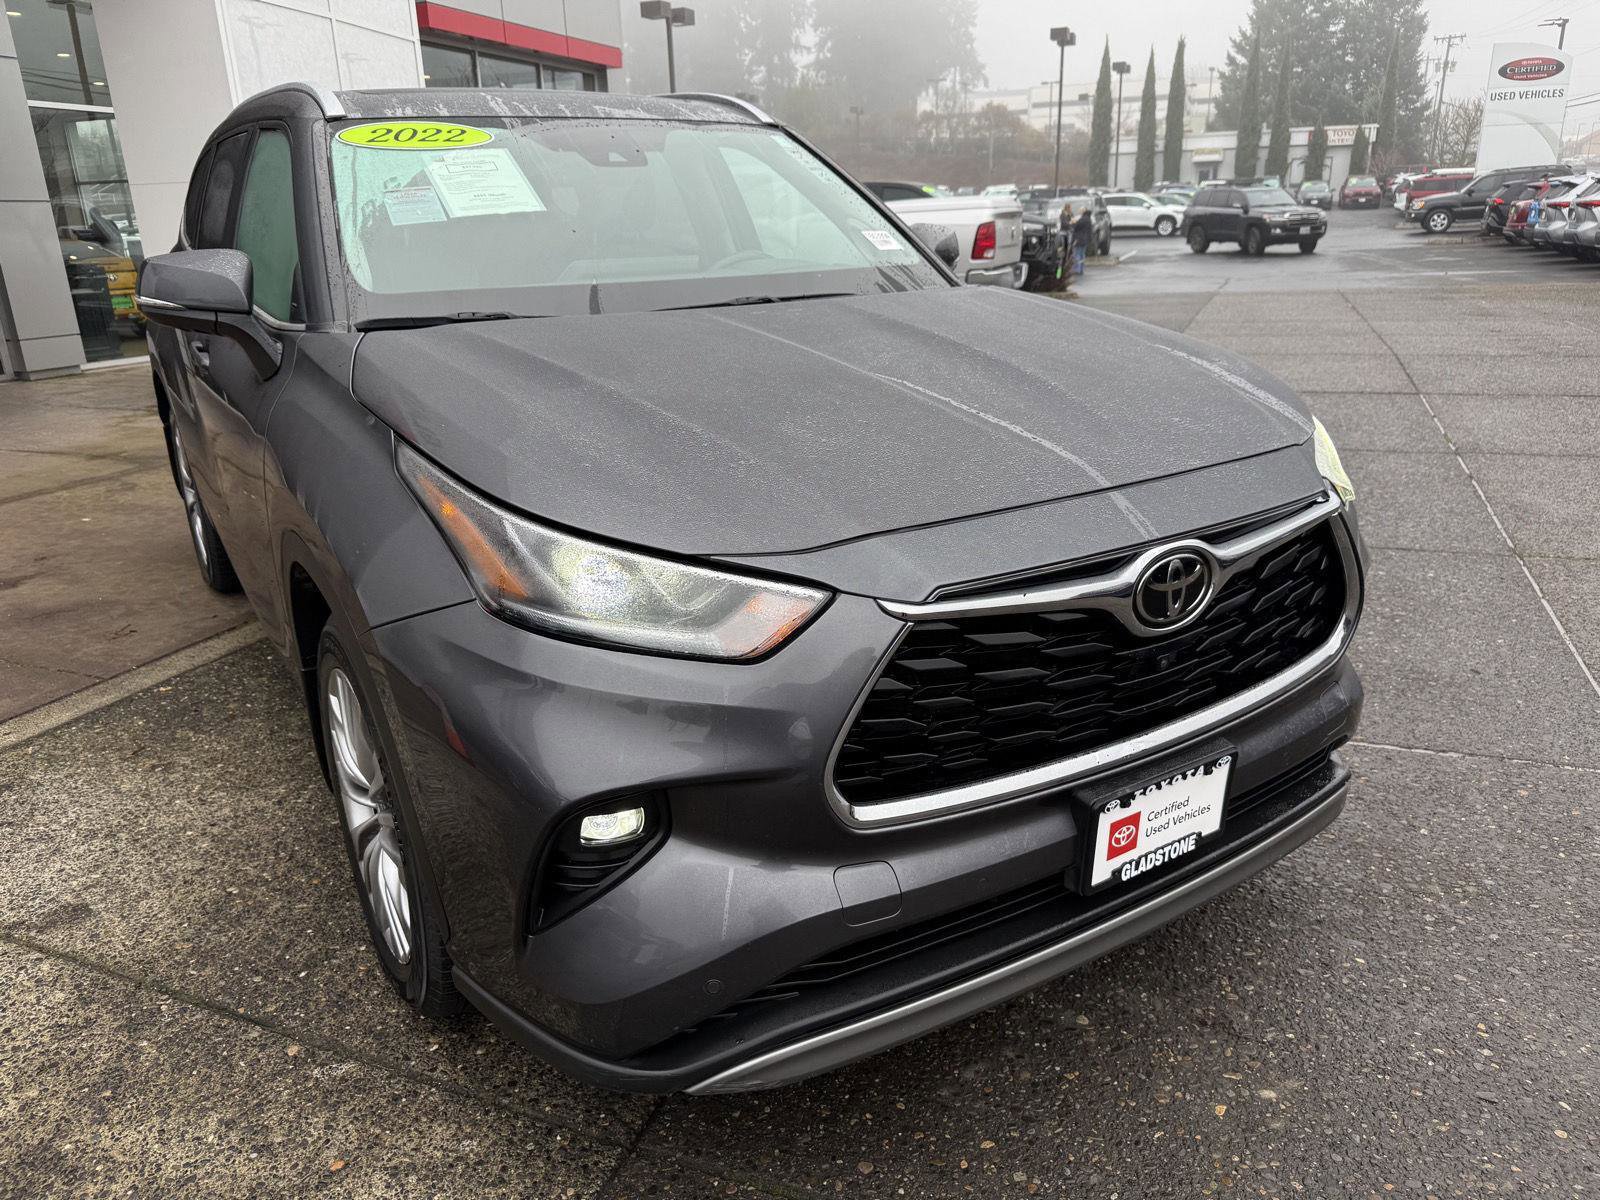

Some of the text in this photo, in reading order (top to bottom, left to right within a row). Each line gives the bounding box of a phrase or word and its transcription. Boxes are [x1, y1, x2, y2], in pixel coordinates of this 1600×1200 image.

[1506, 64, 1557, 74] CERTIFIED
[1490, 88, 1565, 101] USED VEHICLES
[366, 127, 468, 143] 2022
[1131, 765, 1206, 798] TOYOTA
[1145, 803, 1211, 838] Used Vehicles
[1147, 796, 1190, 822] Certified
[1119, 834, 1197, 881] GLADSTONE
